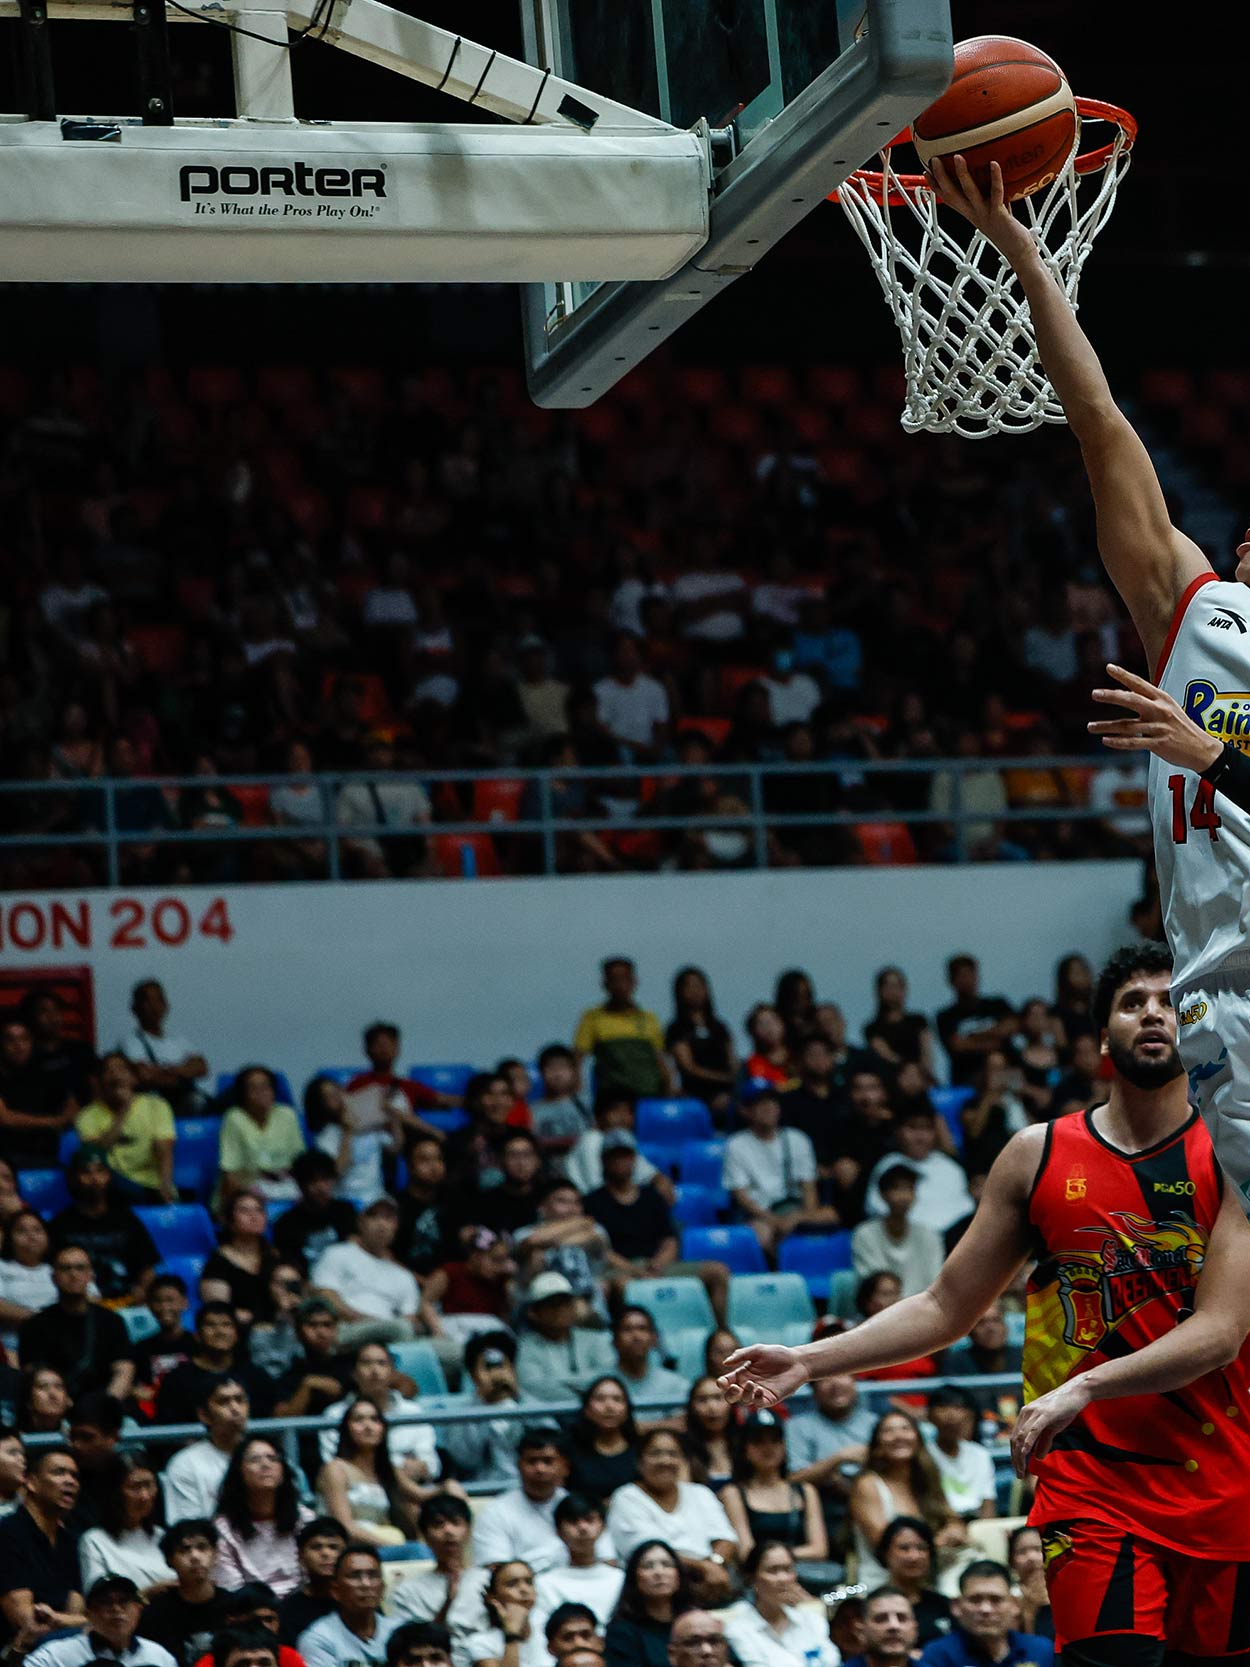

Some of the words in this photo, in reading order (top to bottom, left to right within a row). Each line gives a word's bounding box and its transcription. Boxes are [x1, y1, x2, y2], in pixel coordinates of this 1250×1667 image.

[195, 203, 216, 215] It's
[220, 203, 253, 215] What
[258, 204, 279, 216] the
[283, 205, 313, 217] Pros
[317, 205, 344, 220] Play
[350, 205, 375, 217] On!
[1207, 616, 1234, 631] ANTA
[1168, 774, 1222, 844] 14
[109, 897, 233, 948] 204
